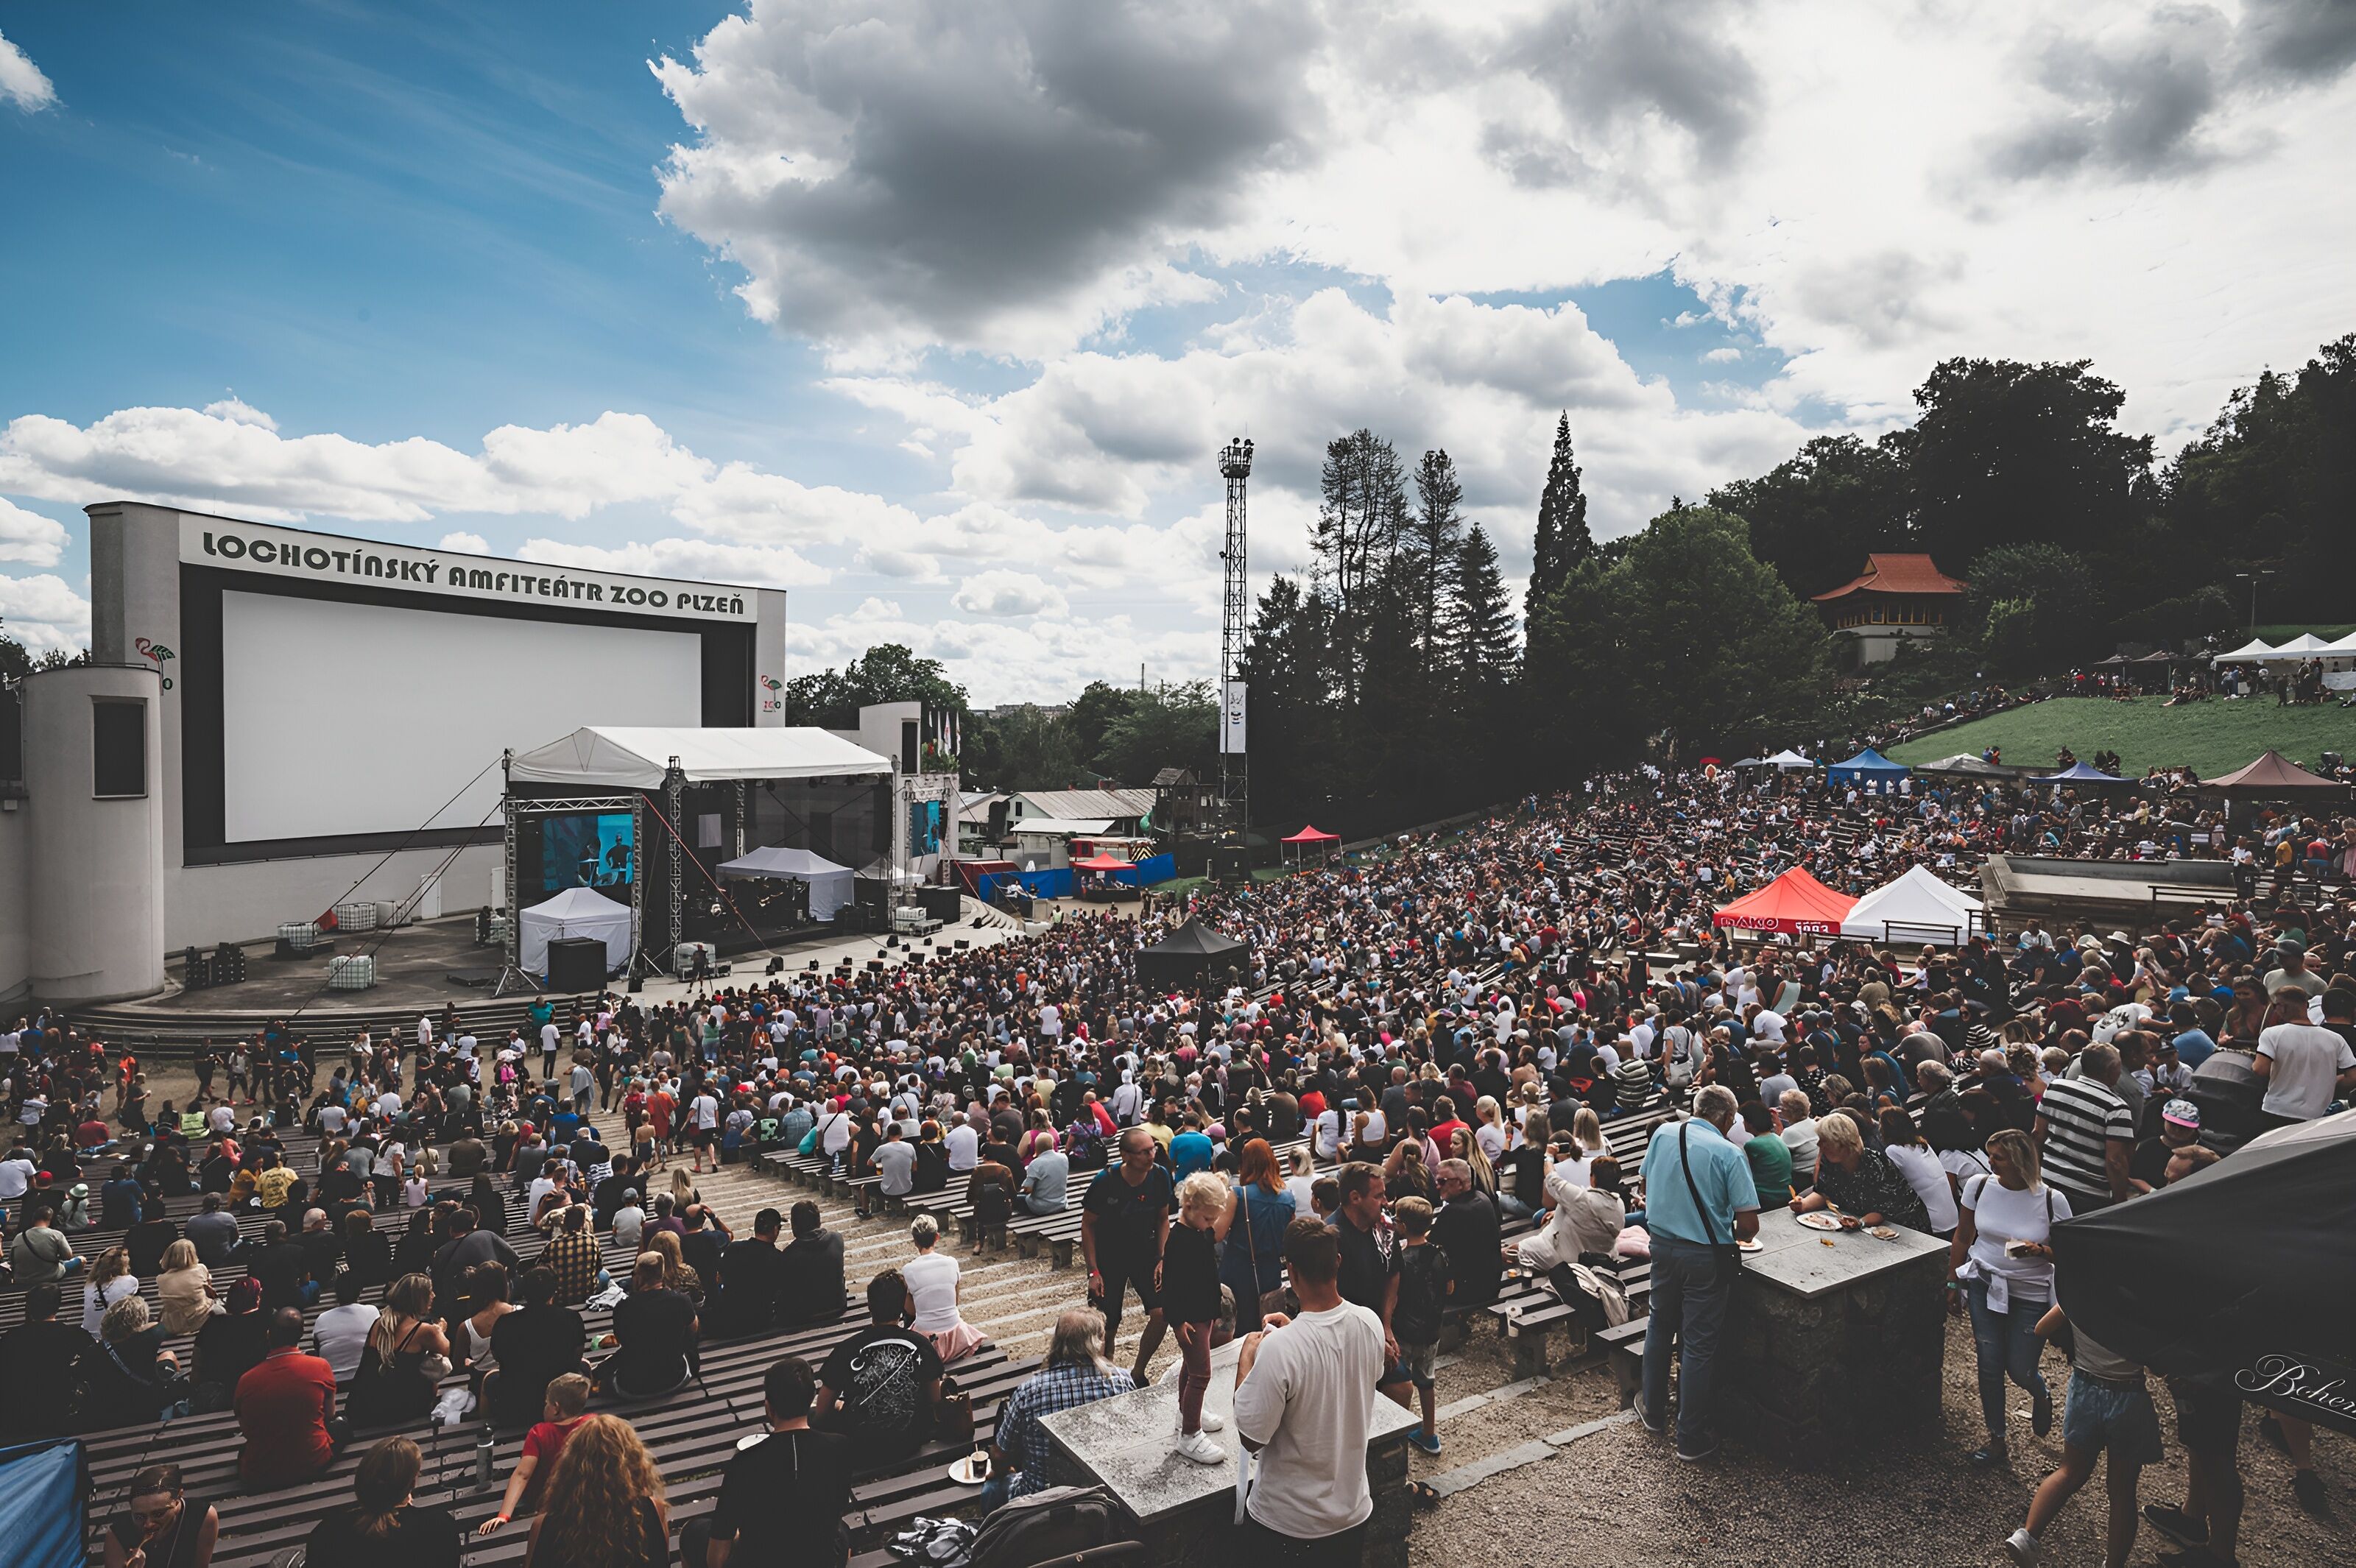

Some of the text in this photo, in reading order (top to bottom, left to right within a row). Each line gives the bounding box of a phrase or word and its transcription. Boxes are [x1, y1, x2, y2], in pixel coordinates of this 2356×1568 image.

[203, 532, 744, 615] LOCHOTÍNSKÝ AMFITEÁTR ZOO PLZEŇ
